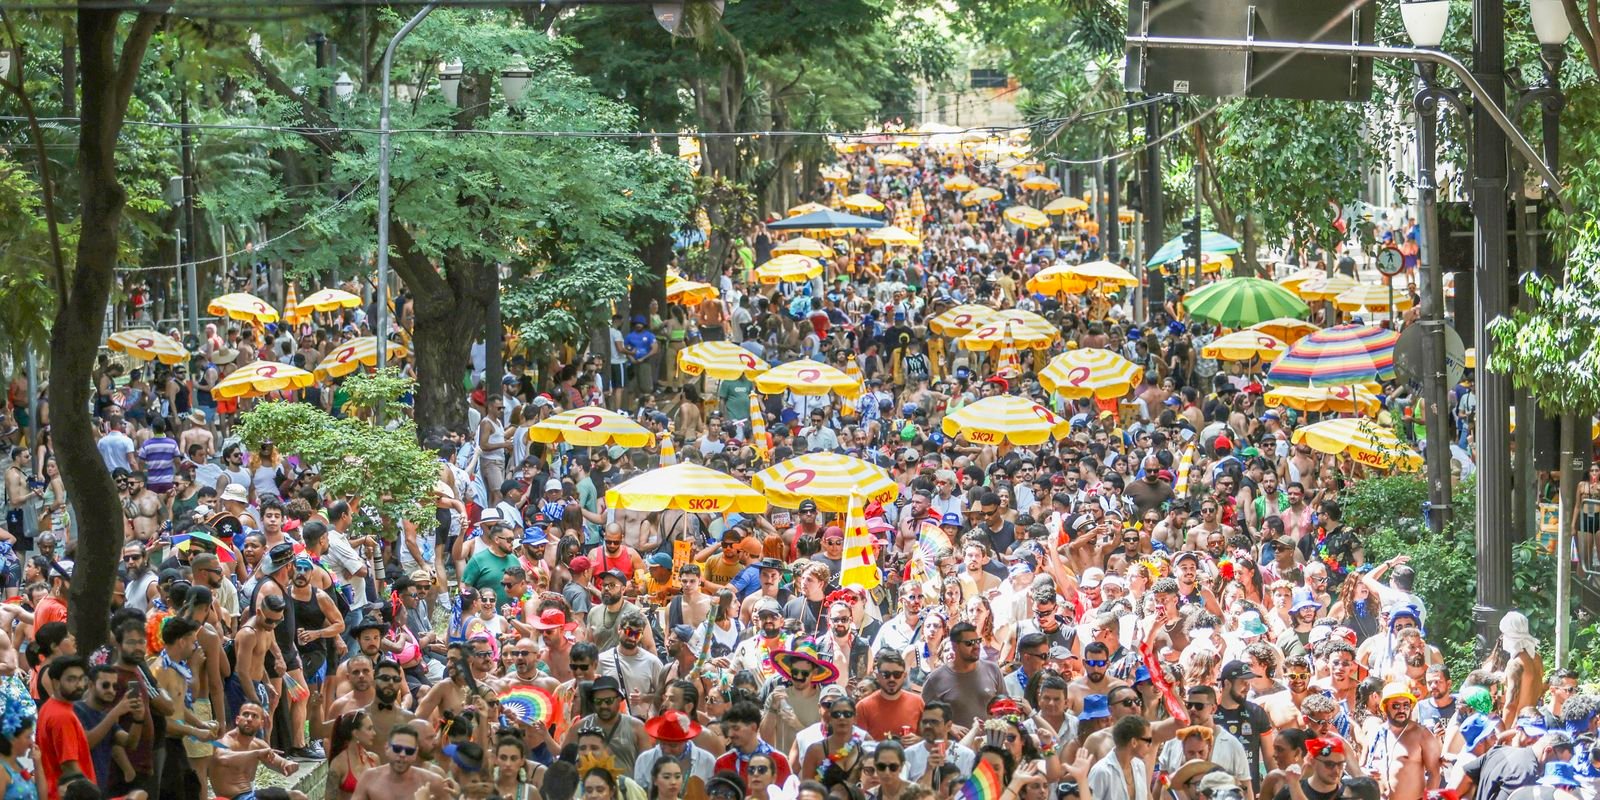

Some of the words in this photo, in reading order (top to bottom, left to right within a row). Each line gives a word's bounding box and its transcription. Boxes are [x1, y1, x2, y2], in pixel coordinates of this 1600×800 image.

[971, 431, 993, 442] SKOL
[1357, 451, 1382, 464] SKOL
[875, 490, 892, 503] SKOL
[688, 498, 719, 510] SKOL
